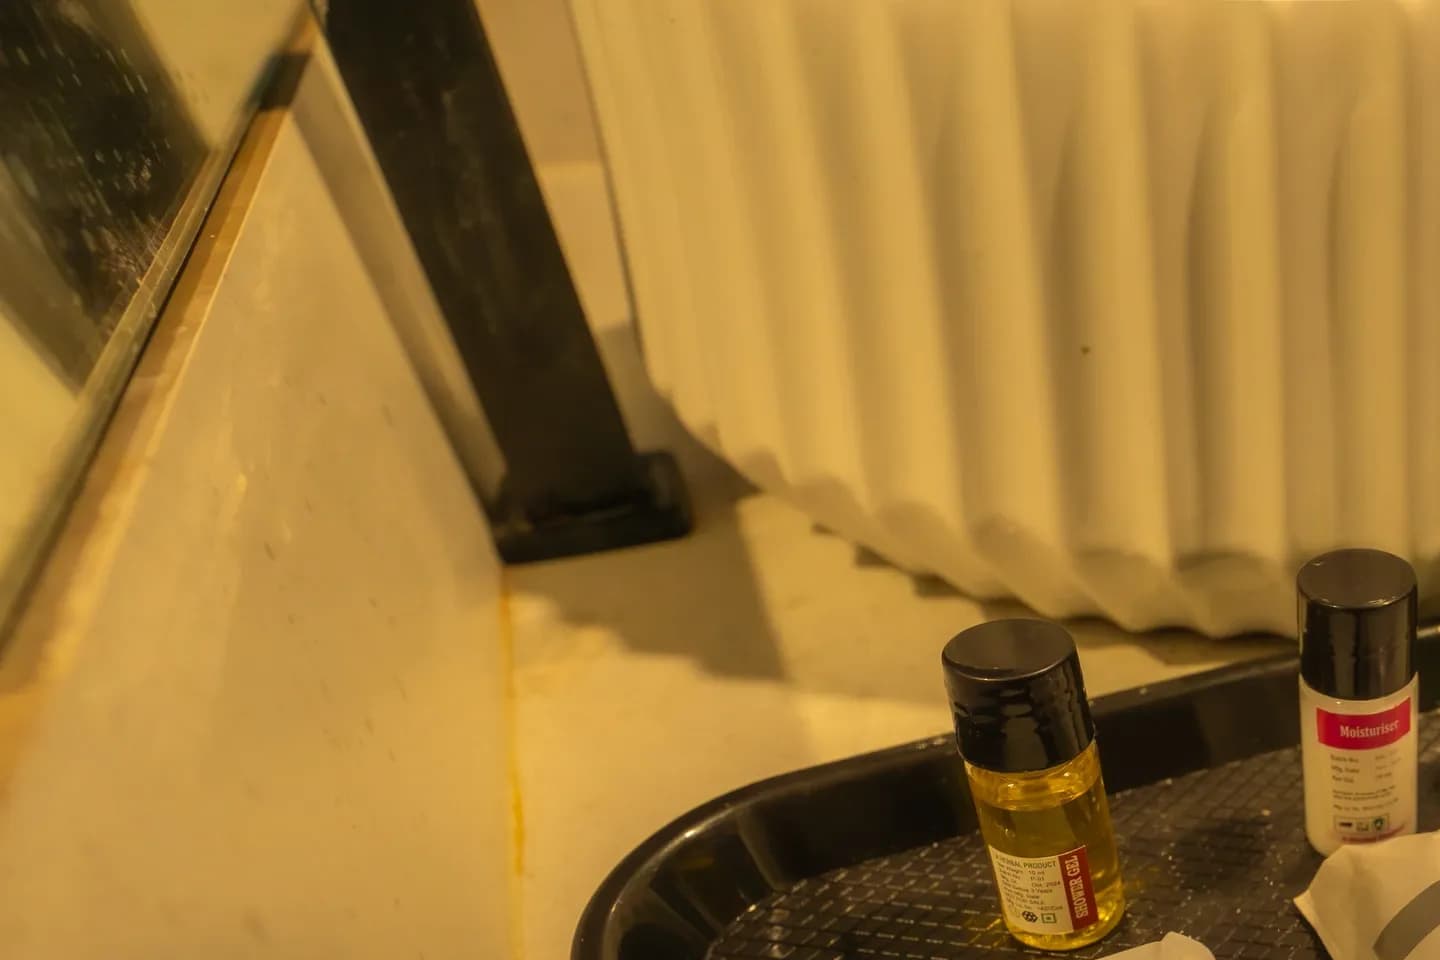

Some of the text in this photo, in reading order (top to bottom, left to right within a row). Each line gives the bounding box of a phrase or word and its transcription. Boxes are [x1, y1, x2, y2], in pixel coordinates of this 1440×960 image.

[1340, 720, 1399, 738] Moisturiser
[1023, 860, 1056, 869] PRODUCT
[1064, 855, 1089, 919] SHOWER GEL
